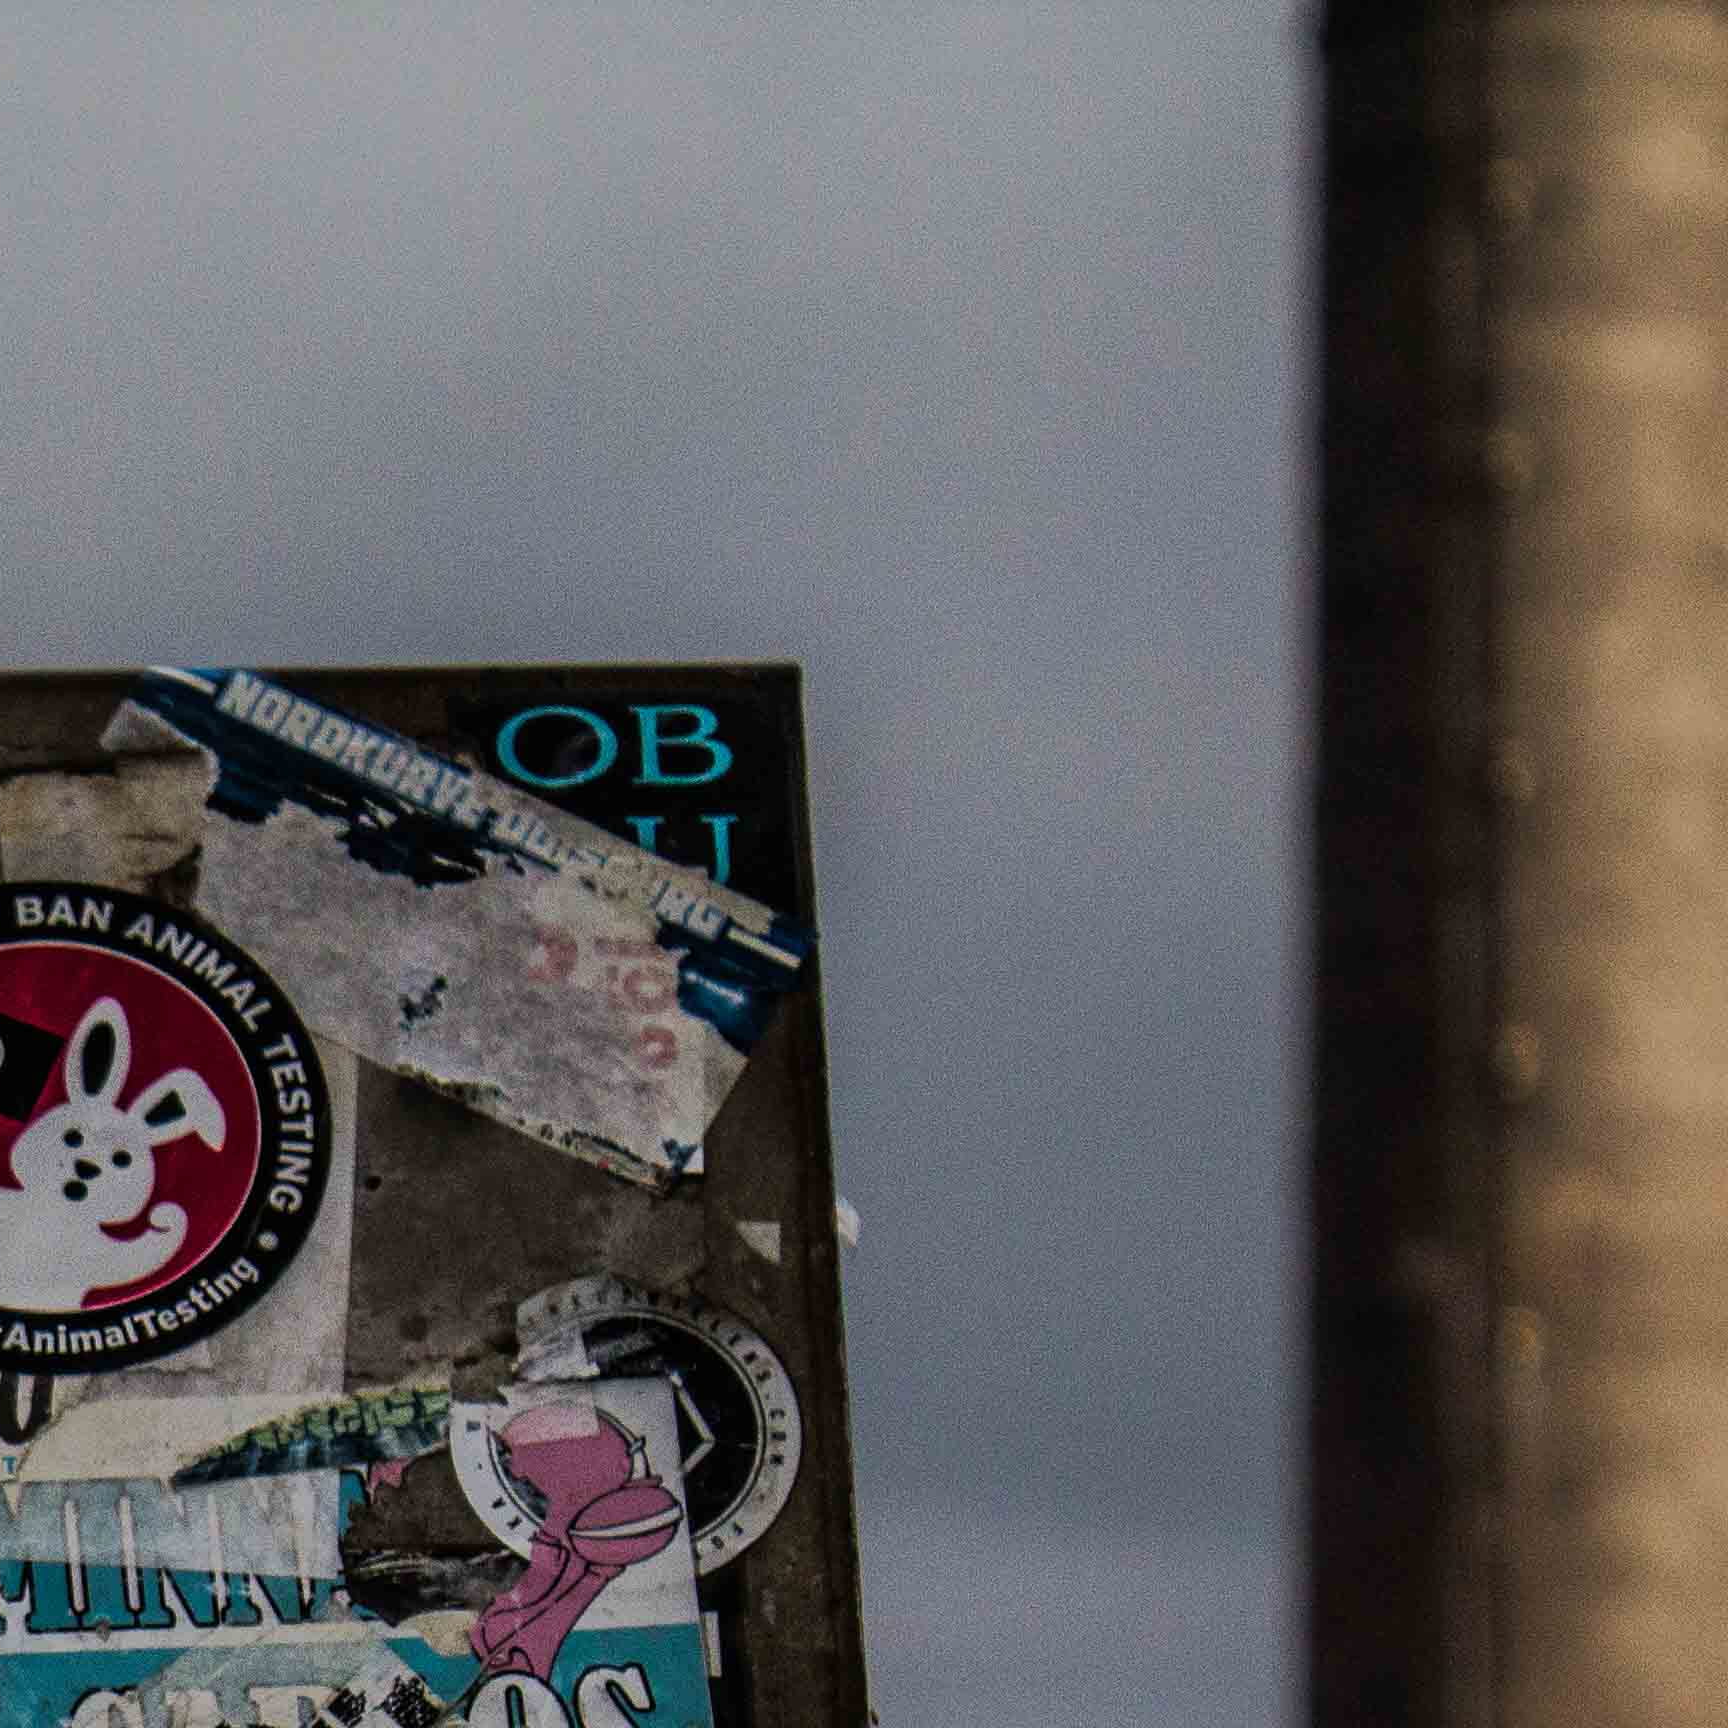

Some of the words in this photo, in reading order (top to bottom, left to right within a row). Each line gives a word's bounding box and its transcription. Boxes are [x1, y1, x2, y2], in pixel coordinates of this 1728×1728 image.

[495, 703, 735, 789] OB
[15, 895, 116, 932] BAN
[126, 912, 273, 1034] ANIMAL
[261, 1032, 315, 1216] TESTING
